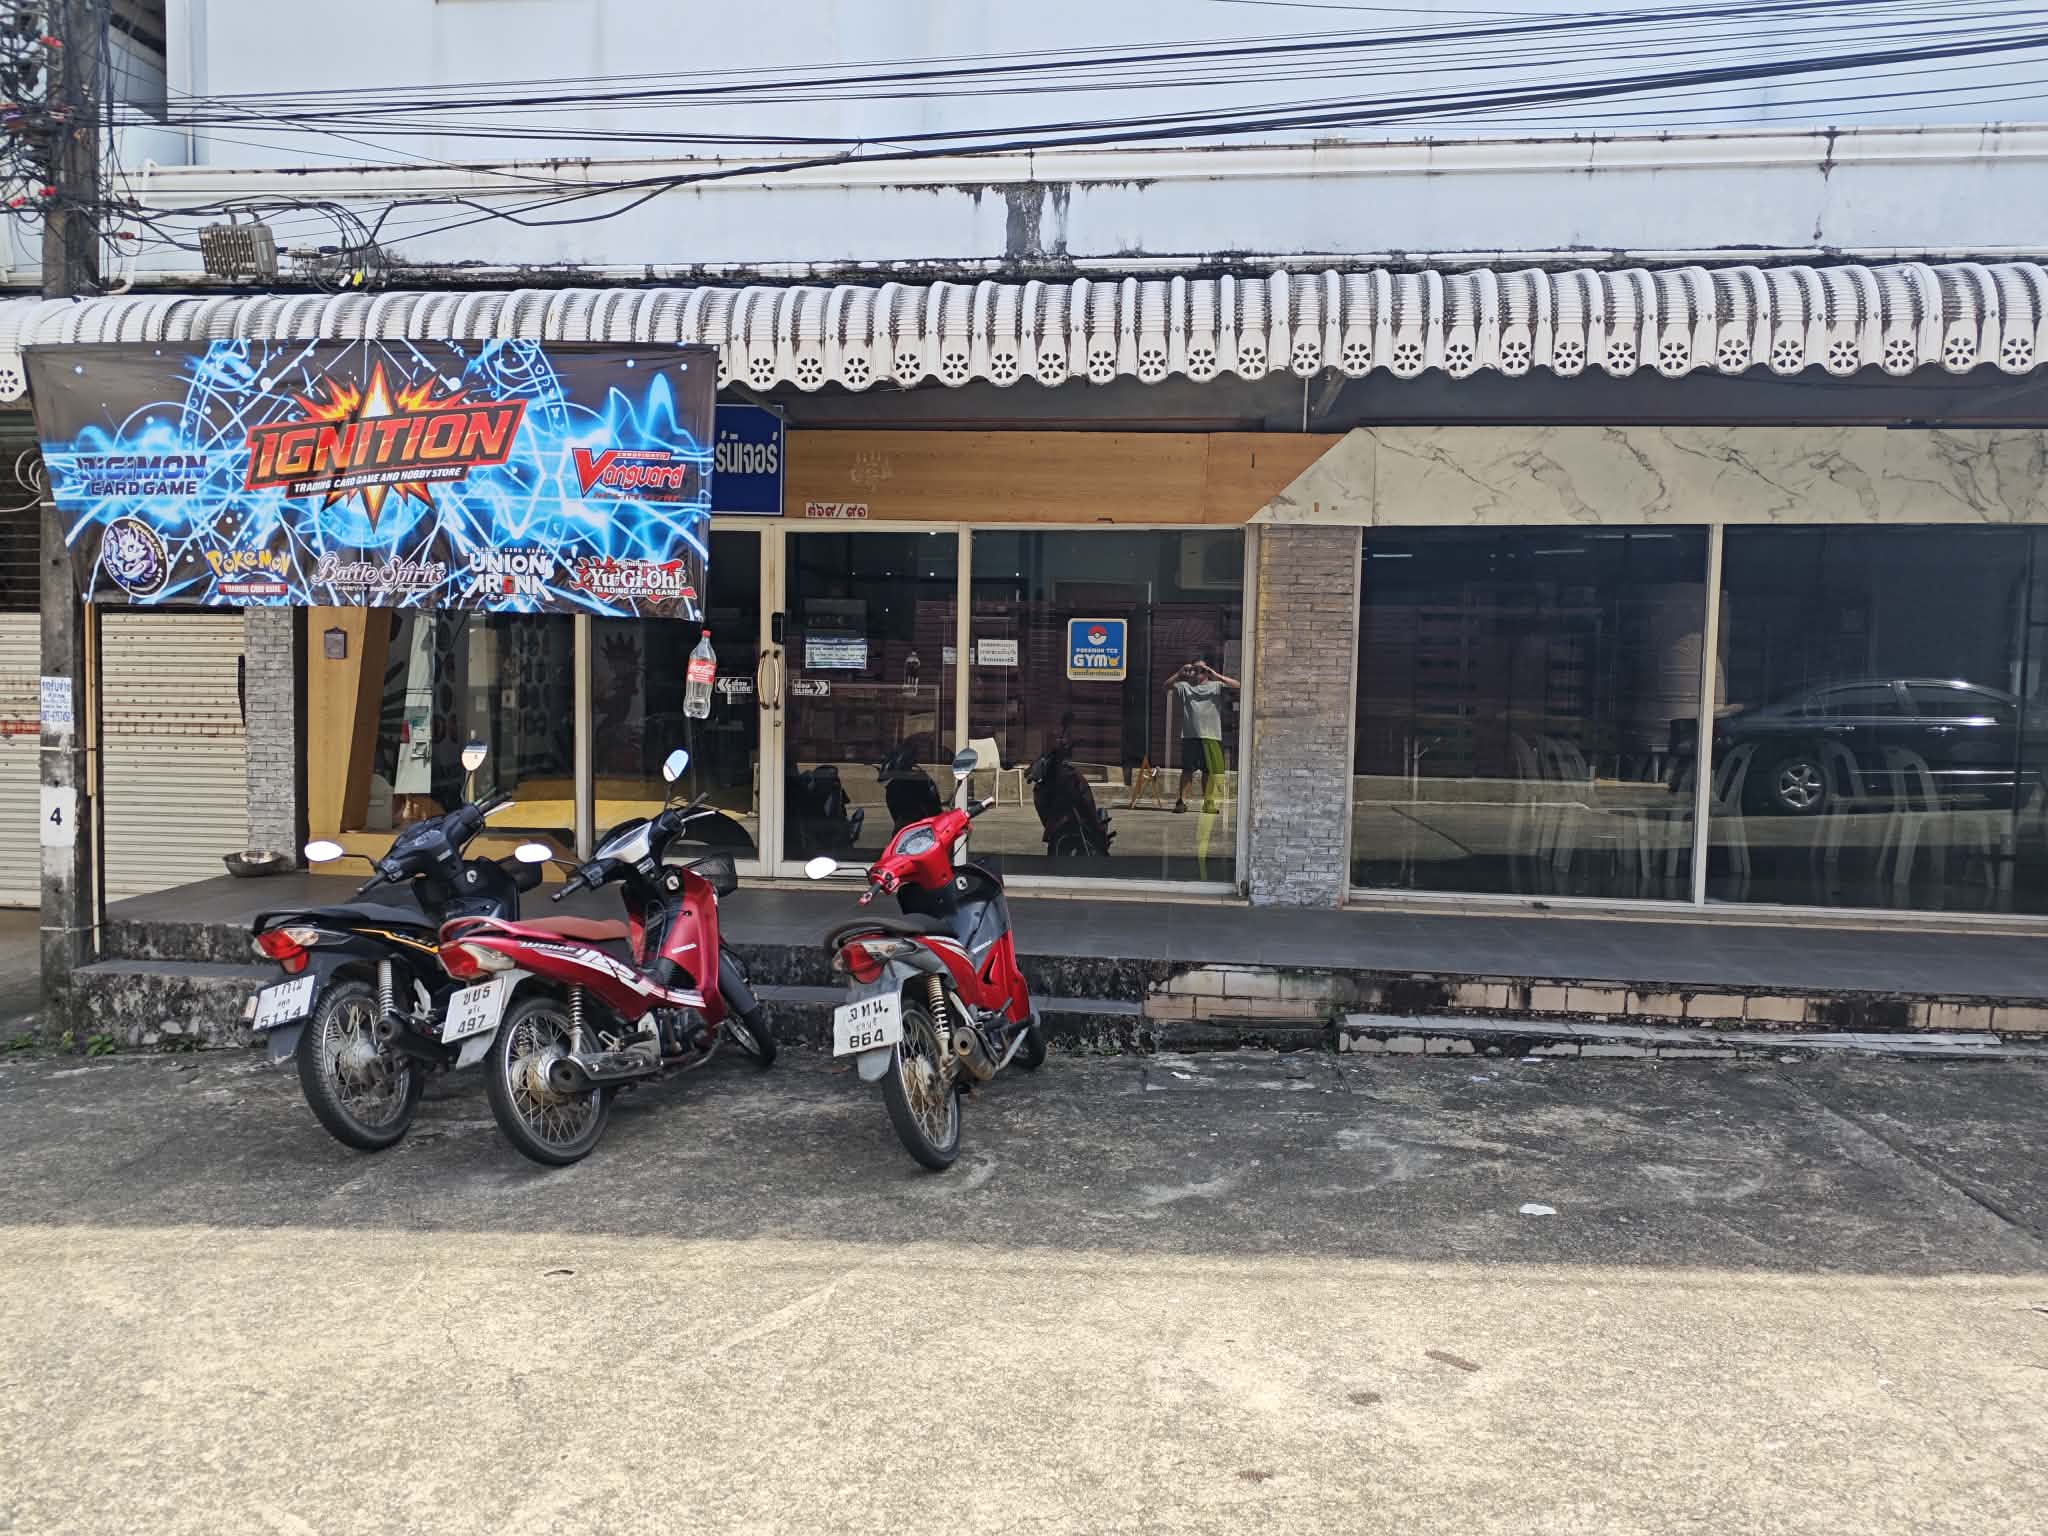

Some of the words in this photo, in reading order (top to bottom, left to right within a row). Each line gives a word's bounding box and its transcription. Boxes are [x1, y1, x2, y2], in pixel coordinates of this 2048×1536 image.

[257, 410, 513, 479] IGNITION
[76, 455, 207, 480] DIGIMON
[294, 481, 332, 493] TRADING
[334, 477, 354, 488] CARD
[356, 474, 379, 485] GAME
[380, 471, 399, 482] AND
[401, 470, 432, 480] HOBBY
[432, 467, 462, 477] STORE
[572, 448, 686, 498] Vanguard
[91, 481, 139, 496] CARD
[143, 481, 197, 496] GAME
[312, 551, 379, 584] Battle
[381, 555, 447, 587] Spirits
[469, 552, 547, 574] UNION
[462, 573, 555, 601] ARENA
[50, 807, 62, 825] 4
[457, 1014, 487, 1033] 497
[849, 1028, 884, 1049] 864
